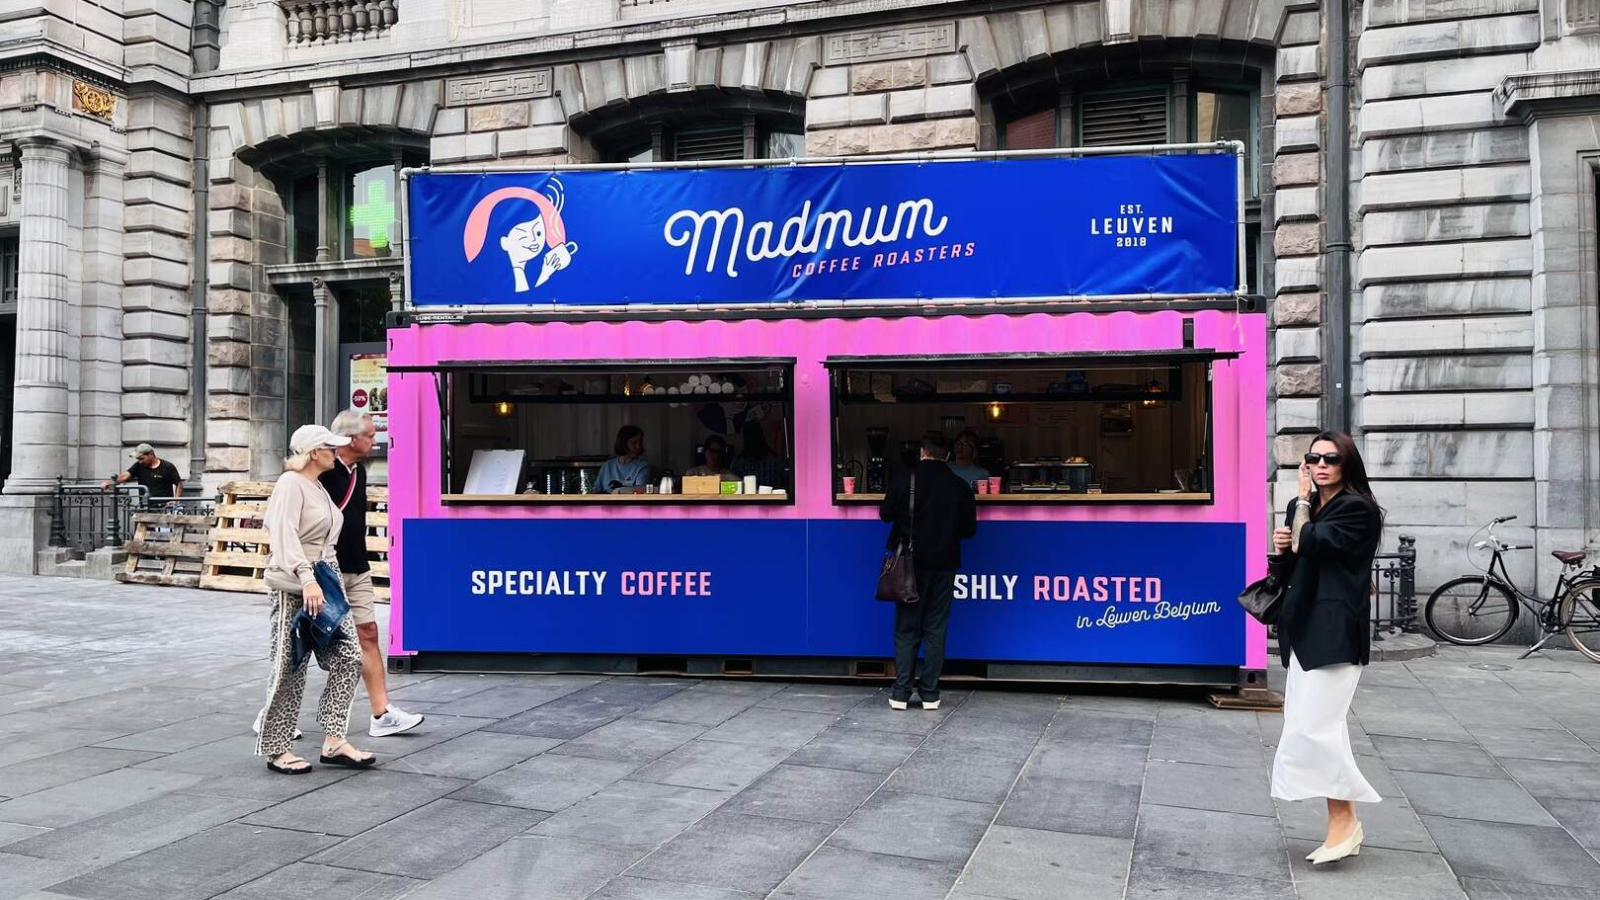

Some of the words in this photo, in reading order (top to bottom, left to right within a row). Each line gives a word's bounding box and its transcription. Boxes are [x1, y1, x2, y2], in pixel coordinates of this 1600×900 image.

[1120, 204, 1144, 214] EST.
[664, 198, 949, 278] Madmum
[1091, 216, 1173, 235] LEUVEN
[1116, 237, 1147, 247] 2018
[791, 255, 861, 278] COFFEE
[872, 241, 976, 268] ROASTERS
[471, 570, 607, 596] SPECIALTY
[621, 571, 712, 596] COFFEE
[953, 574, 1019, 600] SHLY
[1033, 575, 1162, 603] ROASTED
[1076, 614, 1092, 629] in
[1096, 605, 1151, 629] Leuven
[1153, 601, 1221, 621] Belgium
